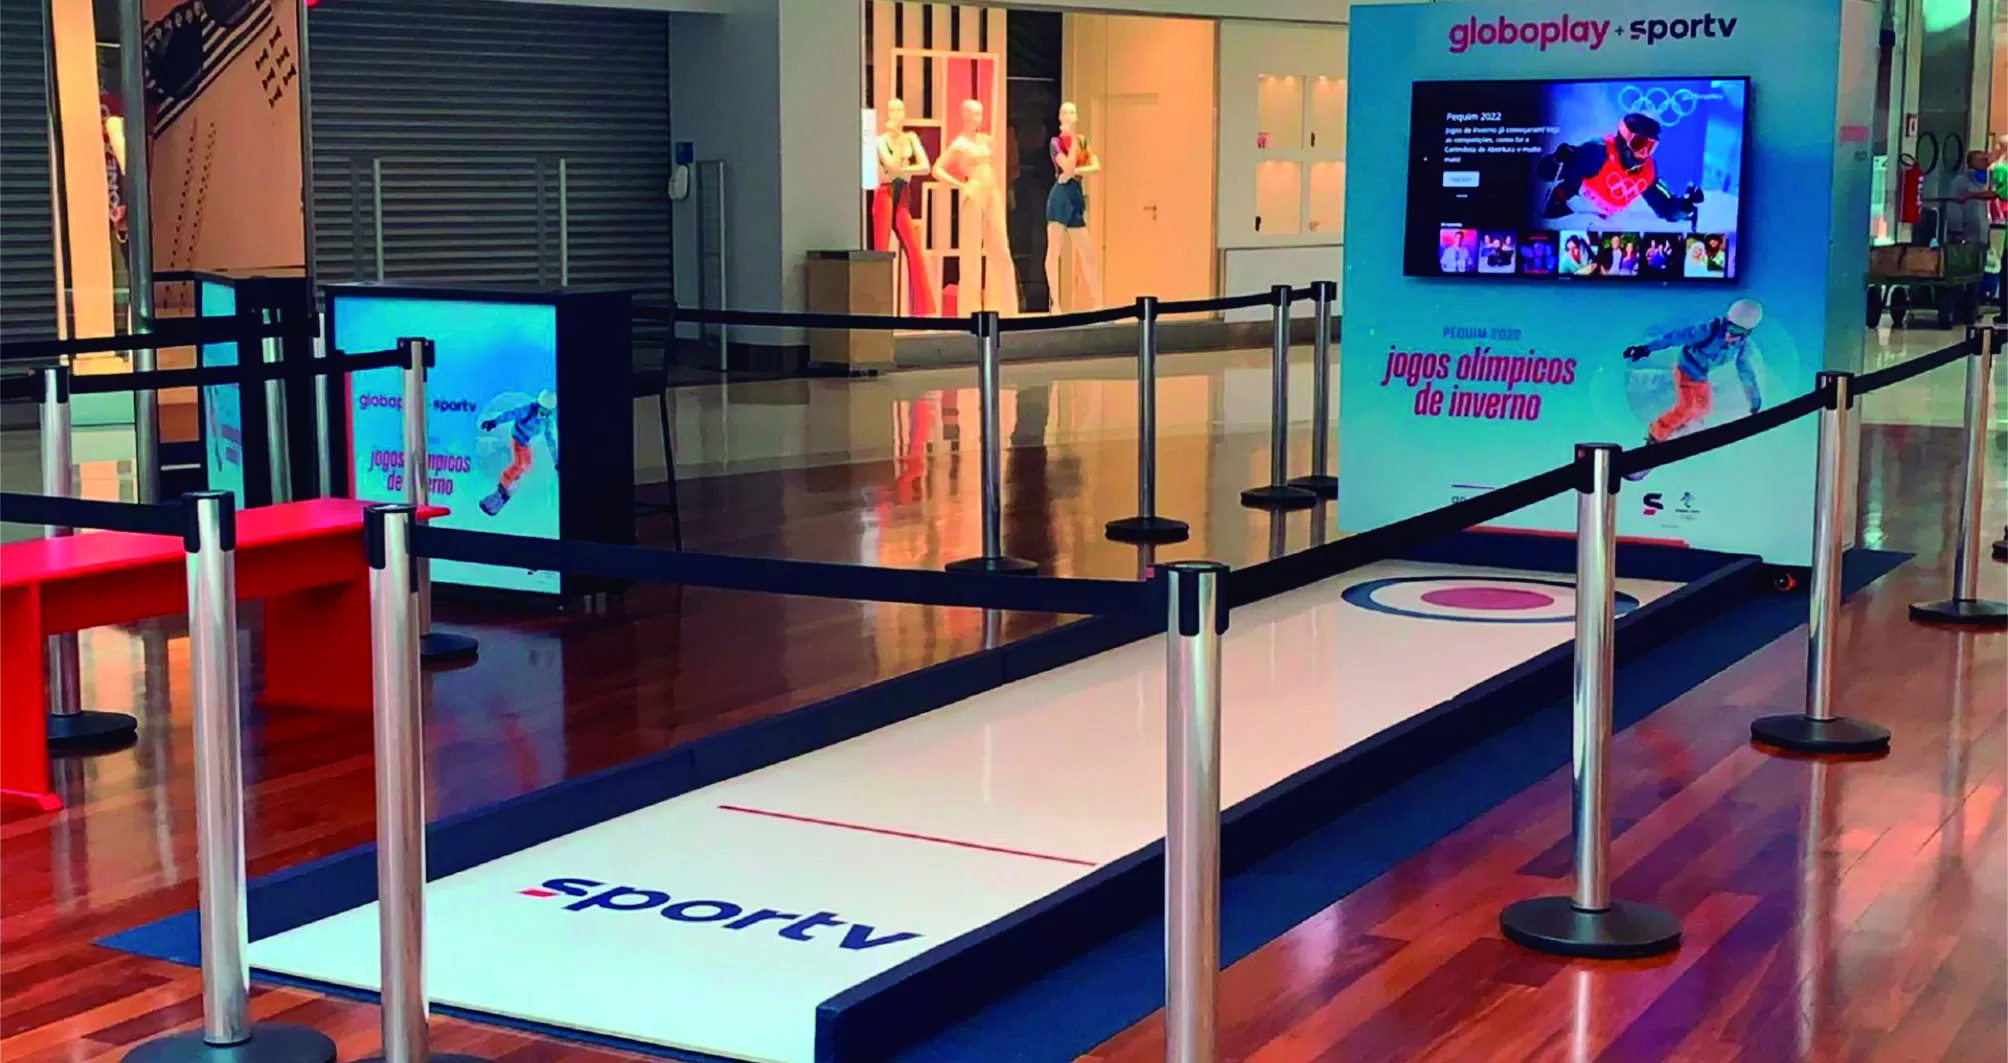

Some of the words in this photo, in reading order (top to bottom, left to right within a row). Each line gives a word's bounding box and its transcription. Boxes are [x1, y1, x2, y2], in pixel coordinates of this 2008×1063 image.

[1449, 13, 1610, 53] globoplay
[1630, 13, 1737, 45] sportv
[1446, 112, 1479, 122] Pequim
[1480, 111, 1502, 121] 2022
[1443, 327, 1487, 339] PEQUIM
[1490, 328, 1522, 340] 2022
[1380, 345, 1451, 387] jogos
[1455, 346, 1577, 391] olímpicos
[433, 399, 476, 412] sportv
[1414, 381, 1444, 416] de
[1448, 384, 1542, 421] inverno
[516, 877, 924, 951] sportv
